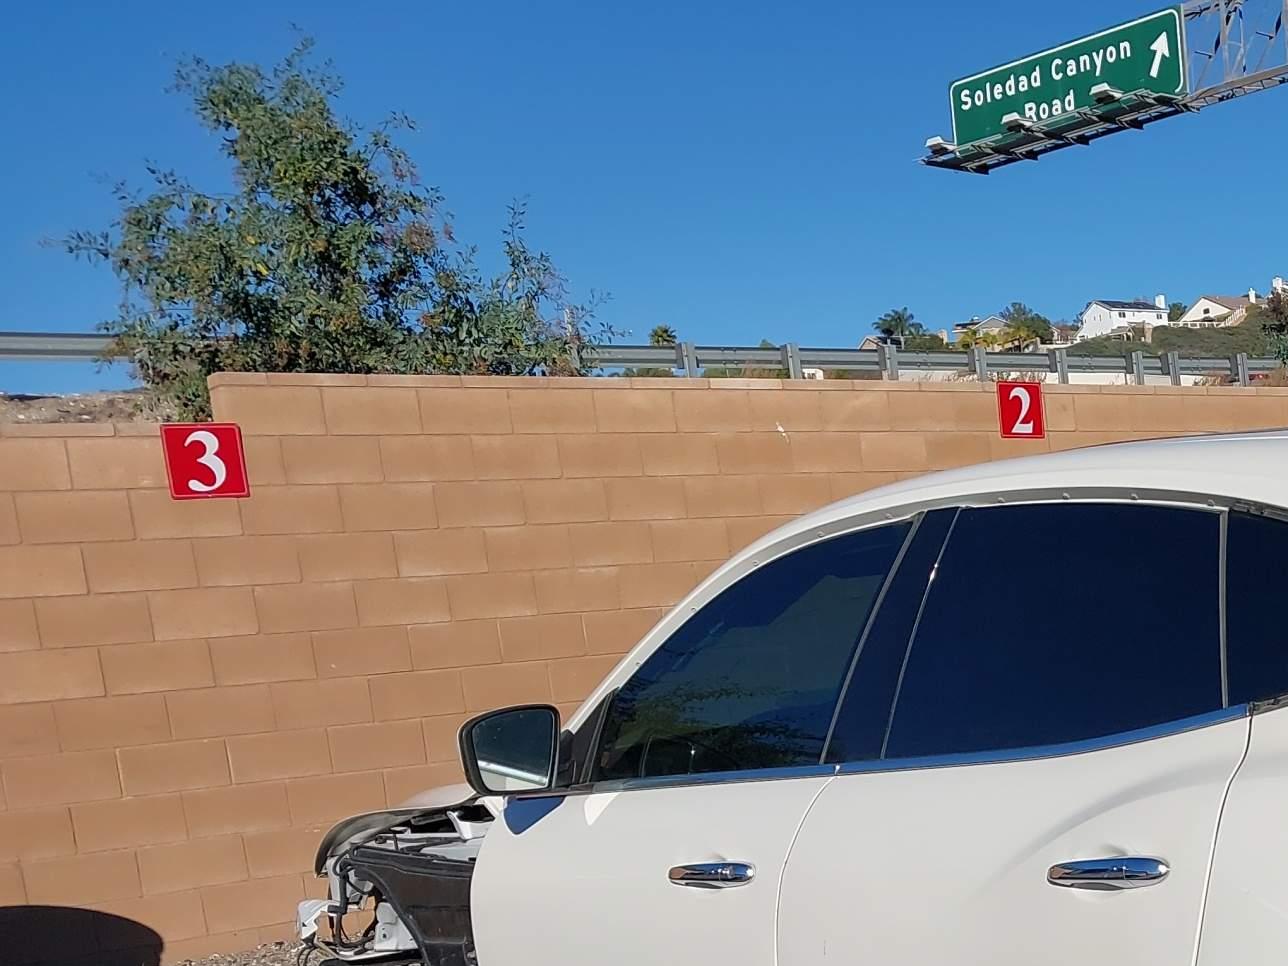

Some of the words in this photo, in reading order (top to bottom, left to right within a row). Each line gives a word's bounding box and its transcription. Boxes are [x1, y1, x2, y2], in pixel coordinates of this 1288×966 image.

[961, 65, 1042, 110] Soledad
[1051, 40, 1132, 81] Canyon
[1025, 89, 1076, 121] Road
[1008, 386, 1034, 434] 2
[183, 430, 227, 492] 3
